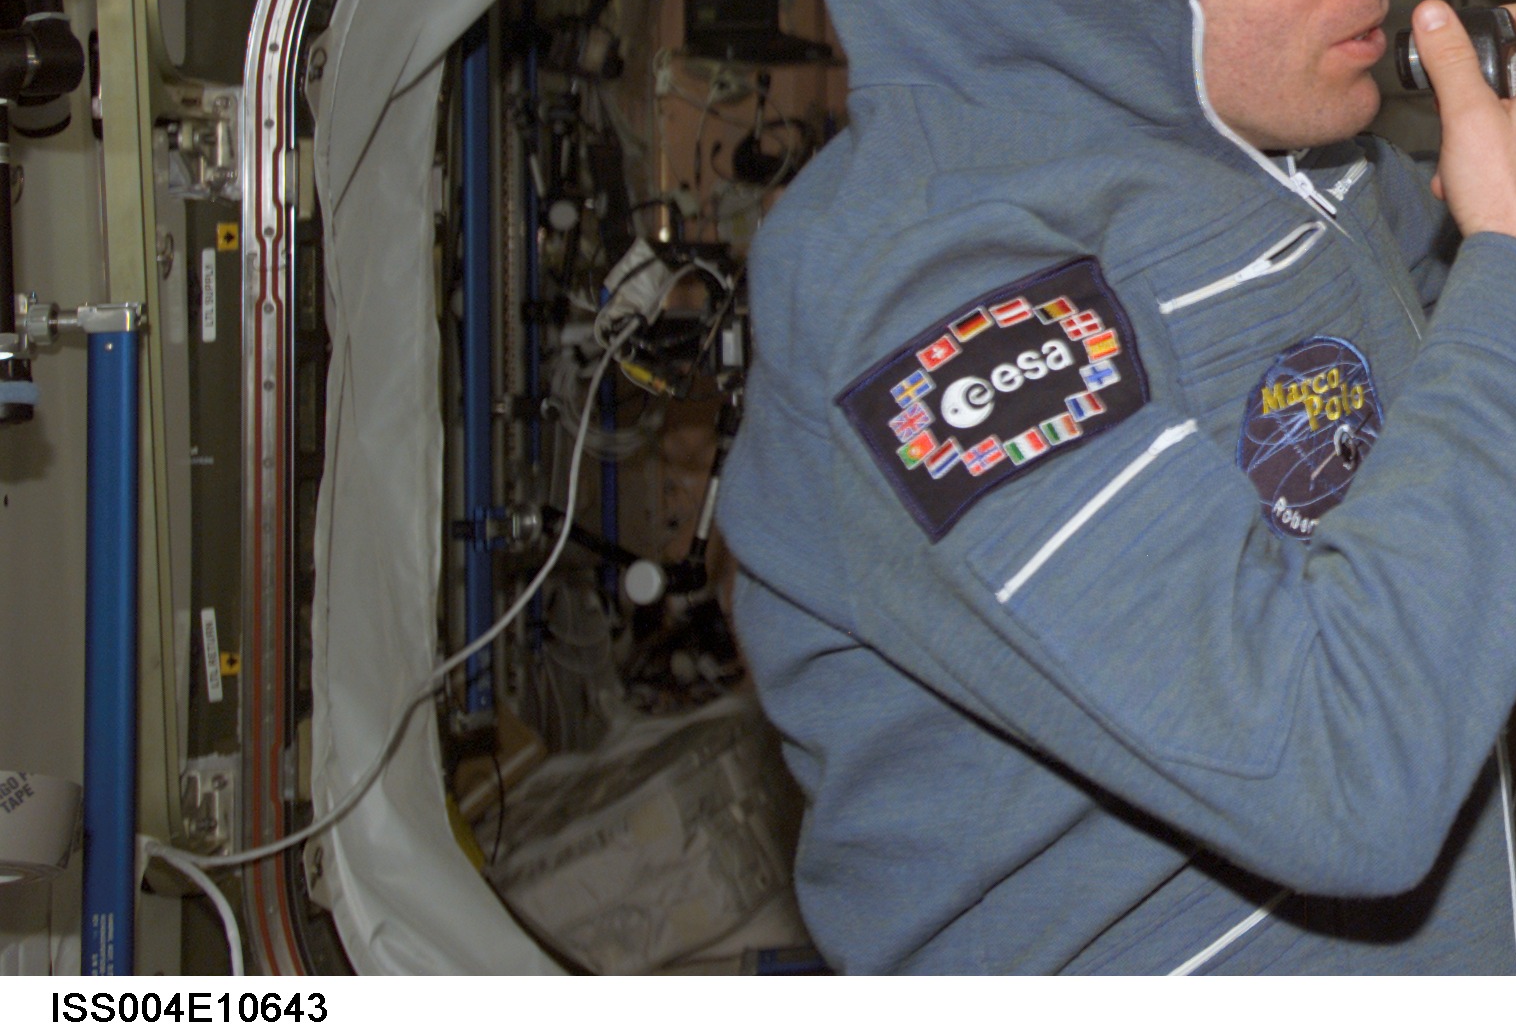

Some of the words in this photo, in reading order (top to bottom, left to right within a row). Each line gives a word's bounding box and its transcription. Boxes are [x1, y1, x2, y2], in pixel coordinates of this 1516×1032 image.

[989, 337, 1075, 397] esa
[1261, 368, 1340, 415] Marco
[1305, 384, 1364, 431] Polo
[0, 783, 36, 814] TAPE
